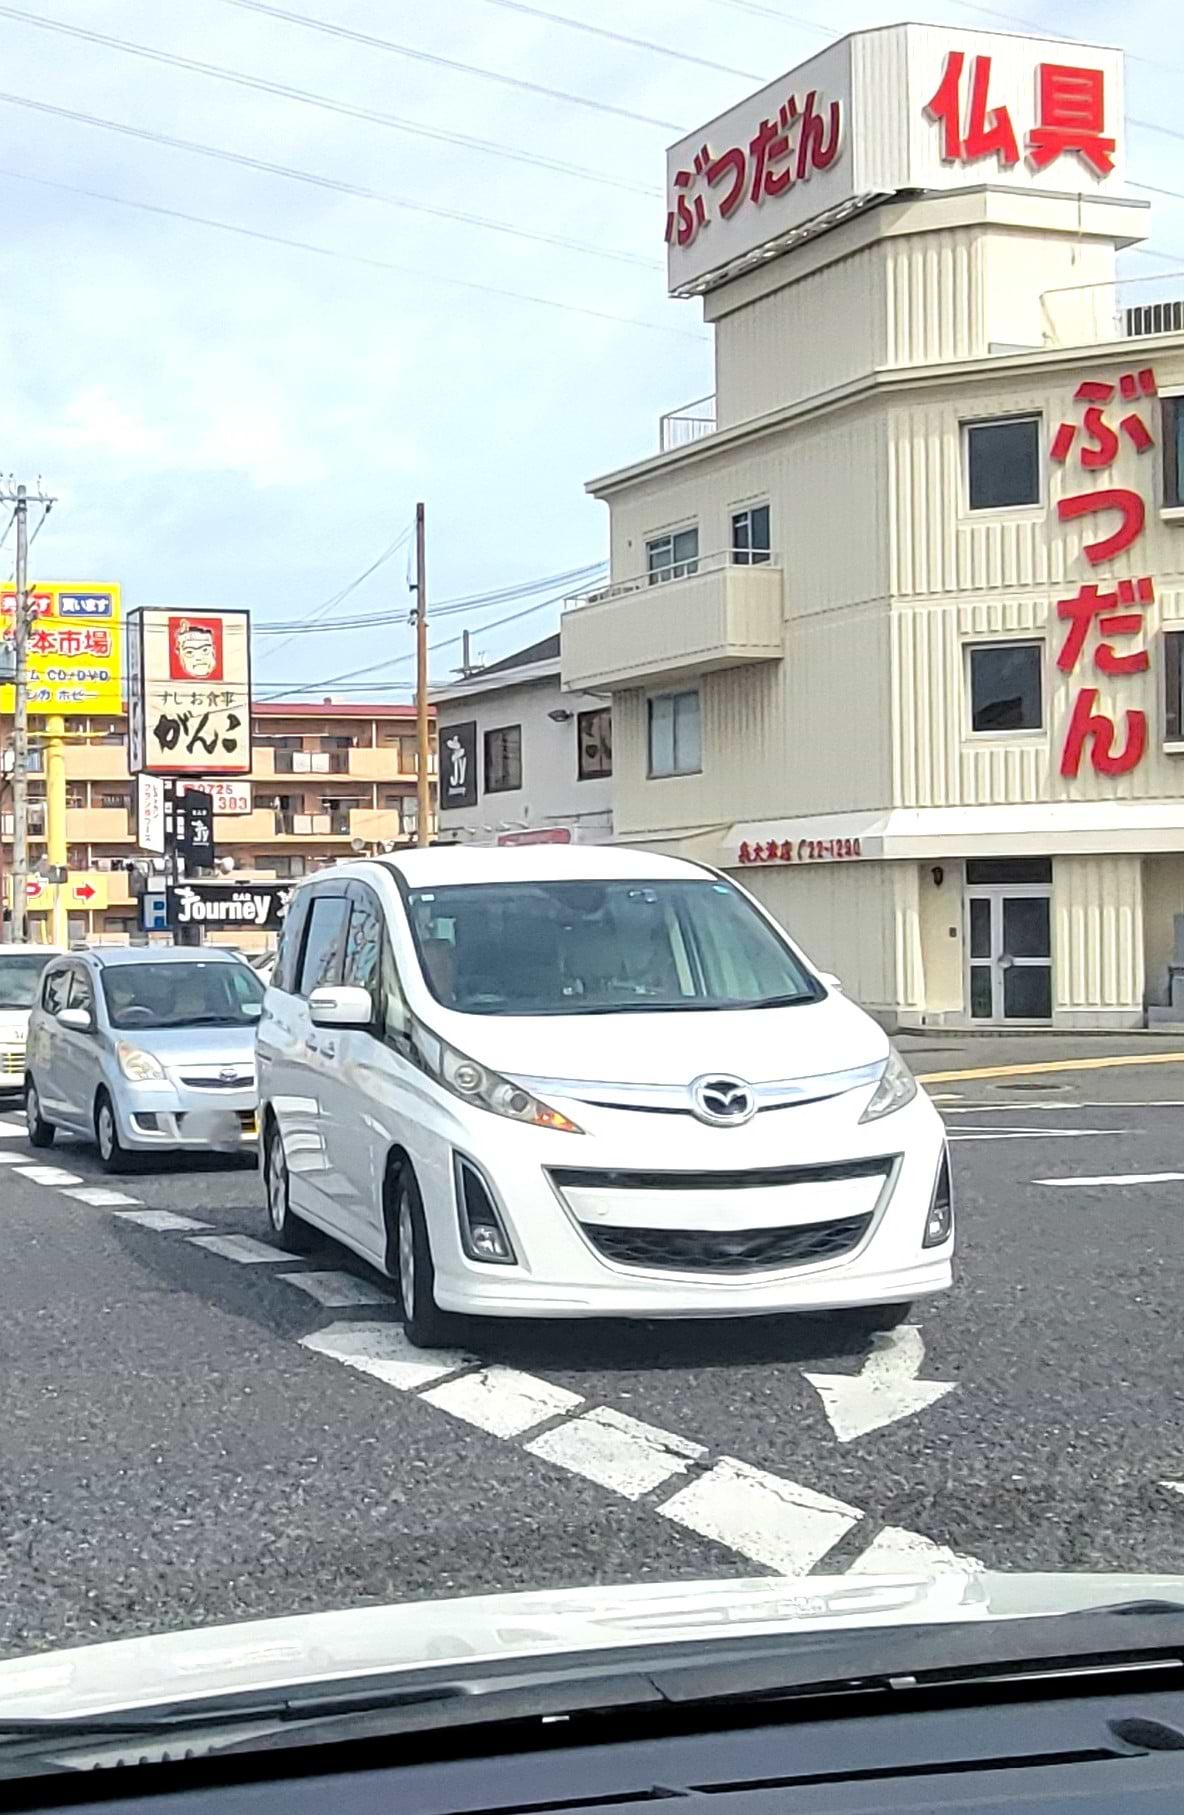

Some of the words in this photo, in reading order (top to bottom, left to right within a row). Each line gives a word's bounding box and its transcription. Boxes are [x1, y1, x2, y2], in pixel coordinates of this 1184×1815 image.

[664, 89, 840, 246] ぶつだん
[923, 51, 1116, 178] 仏具
[1049, 367, 1158, 778] ぶつだん
[153, 710, 241, 755] がんこ
[174, 887, 271, 925] Journey
